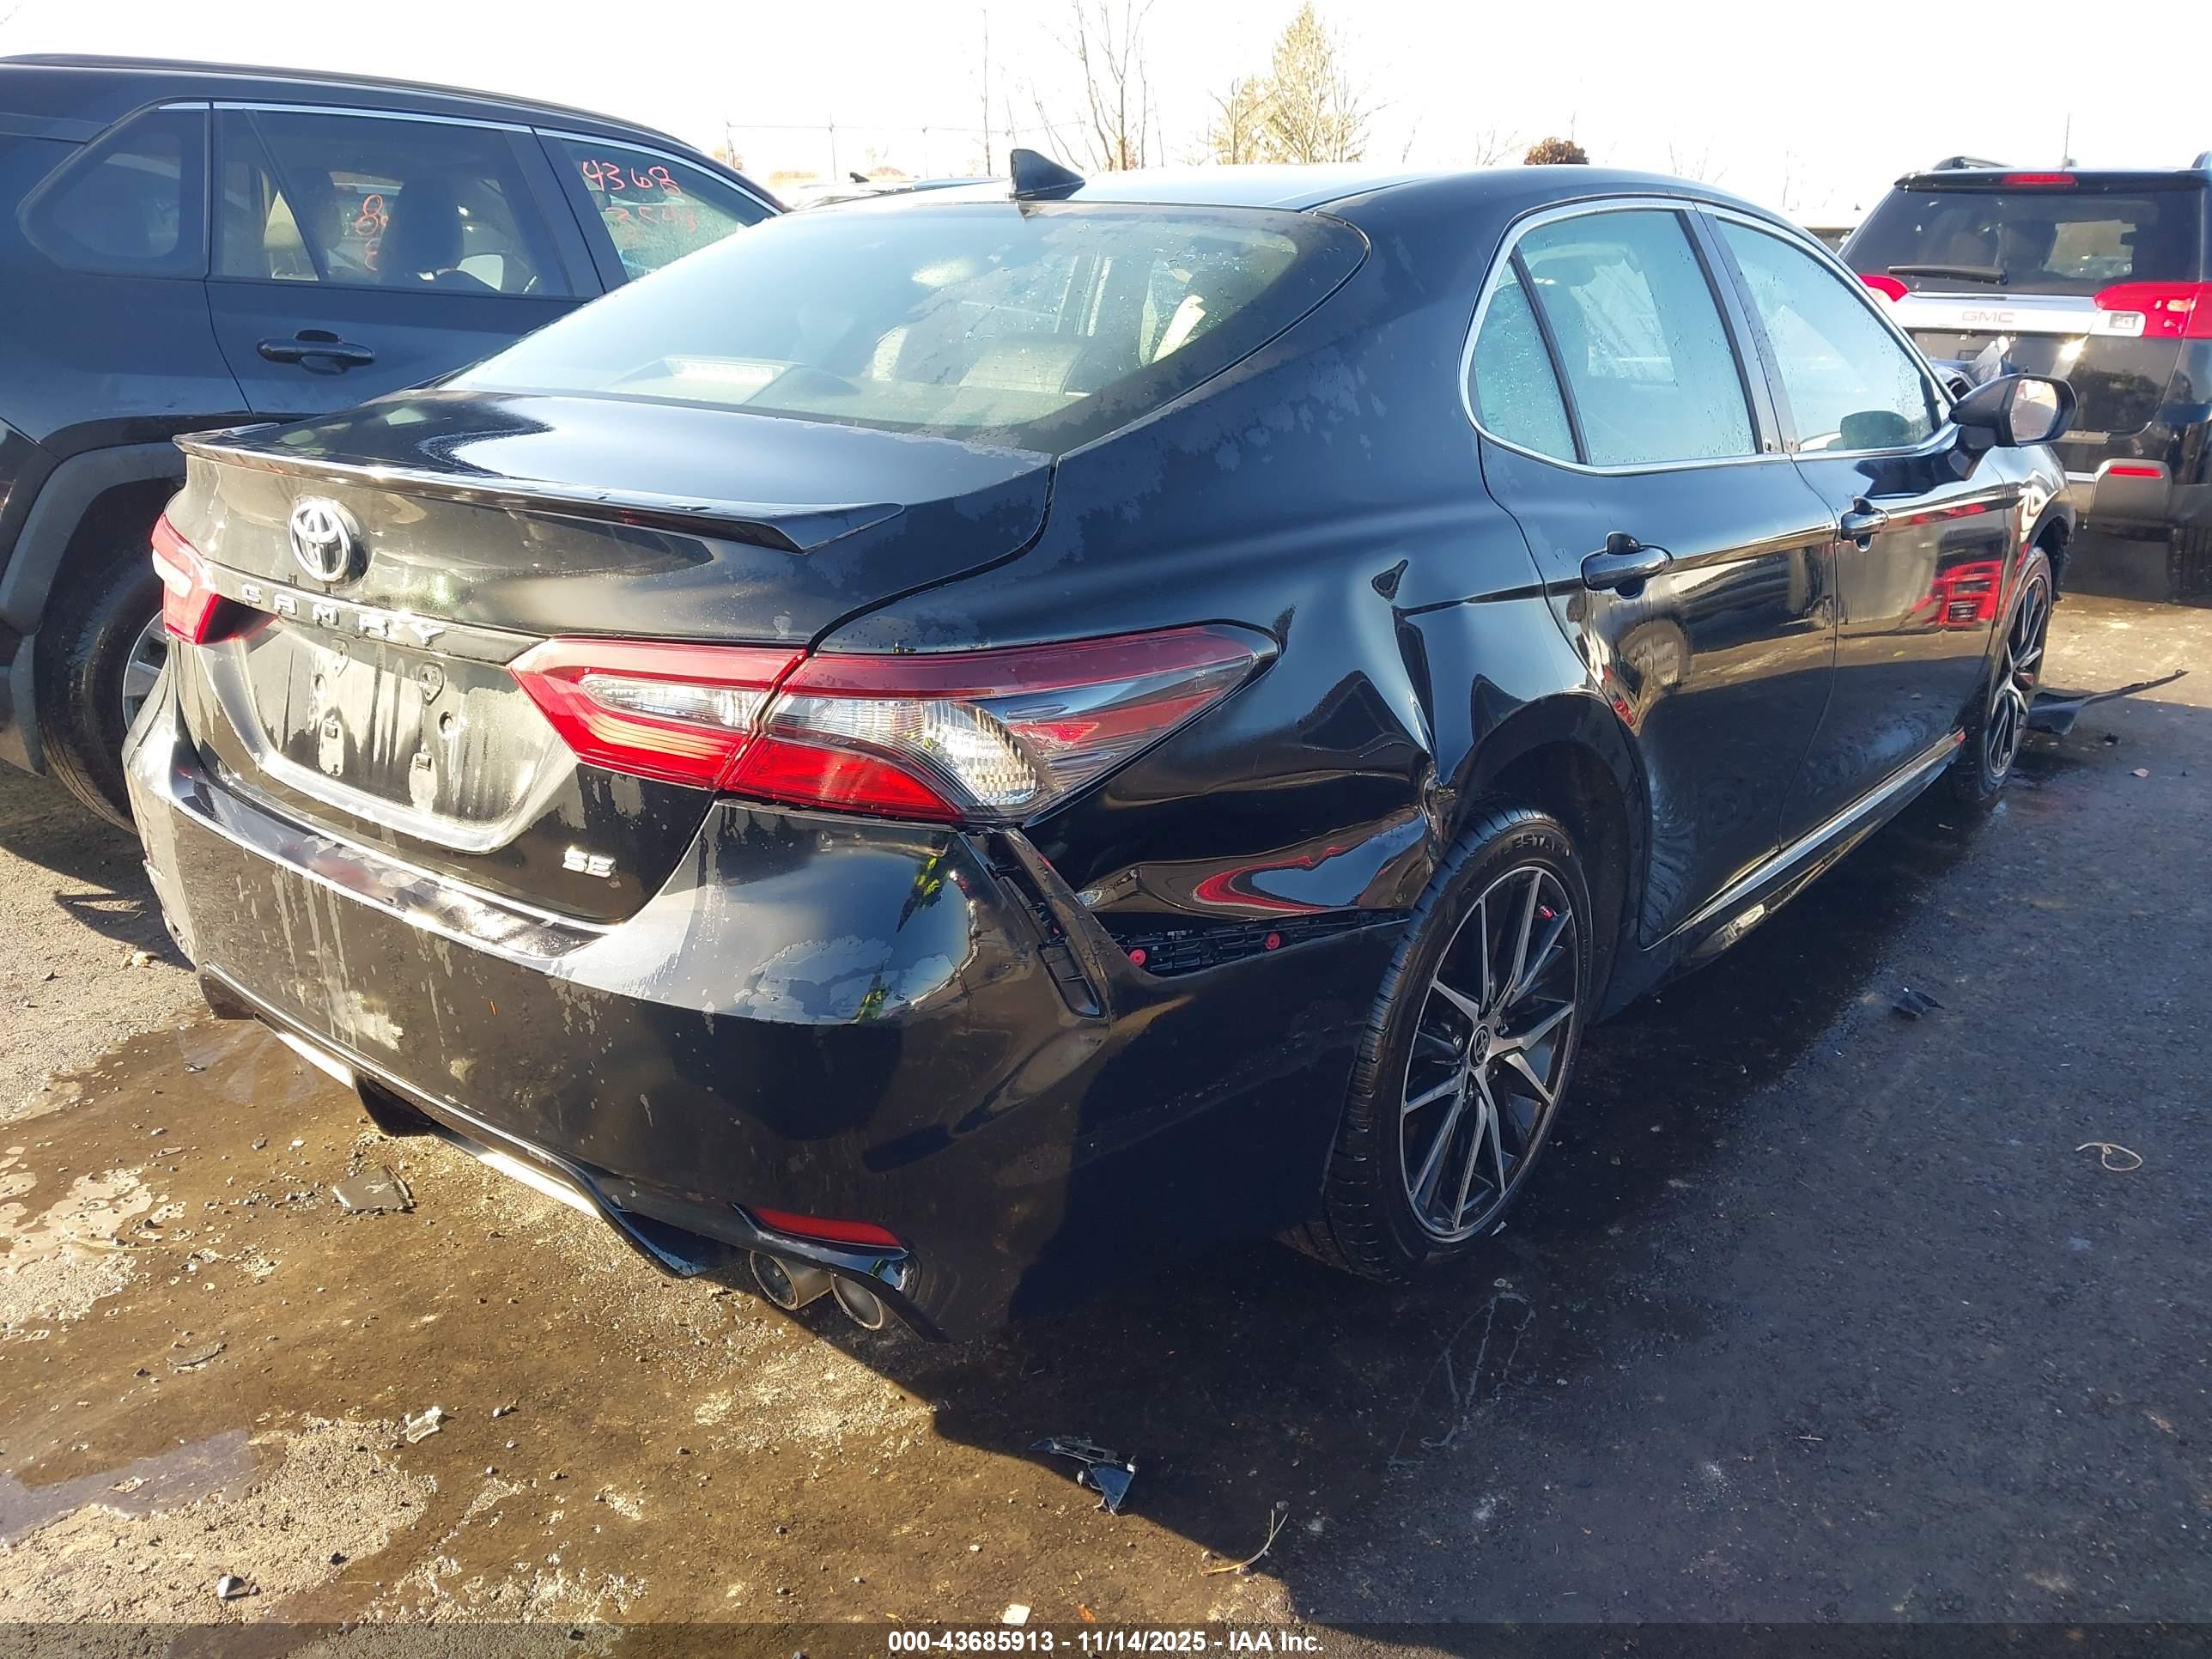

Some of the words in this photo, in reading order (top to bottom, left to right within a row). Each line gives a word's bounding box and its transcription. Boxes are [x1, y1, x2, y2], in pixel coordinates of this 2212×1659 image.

[582, 160, 682, 197] 4368
[1961, 310, 2015, 324] GMC
[562, 845, 617, 878] SE
